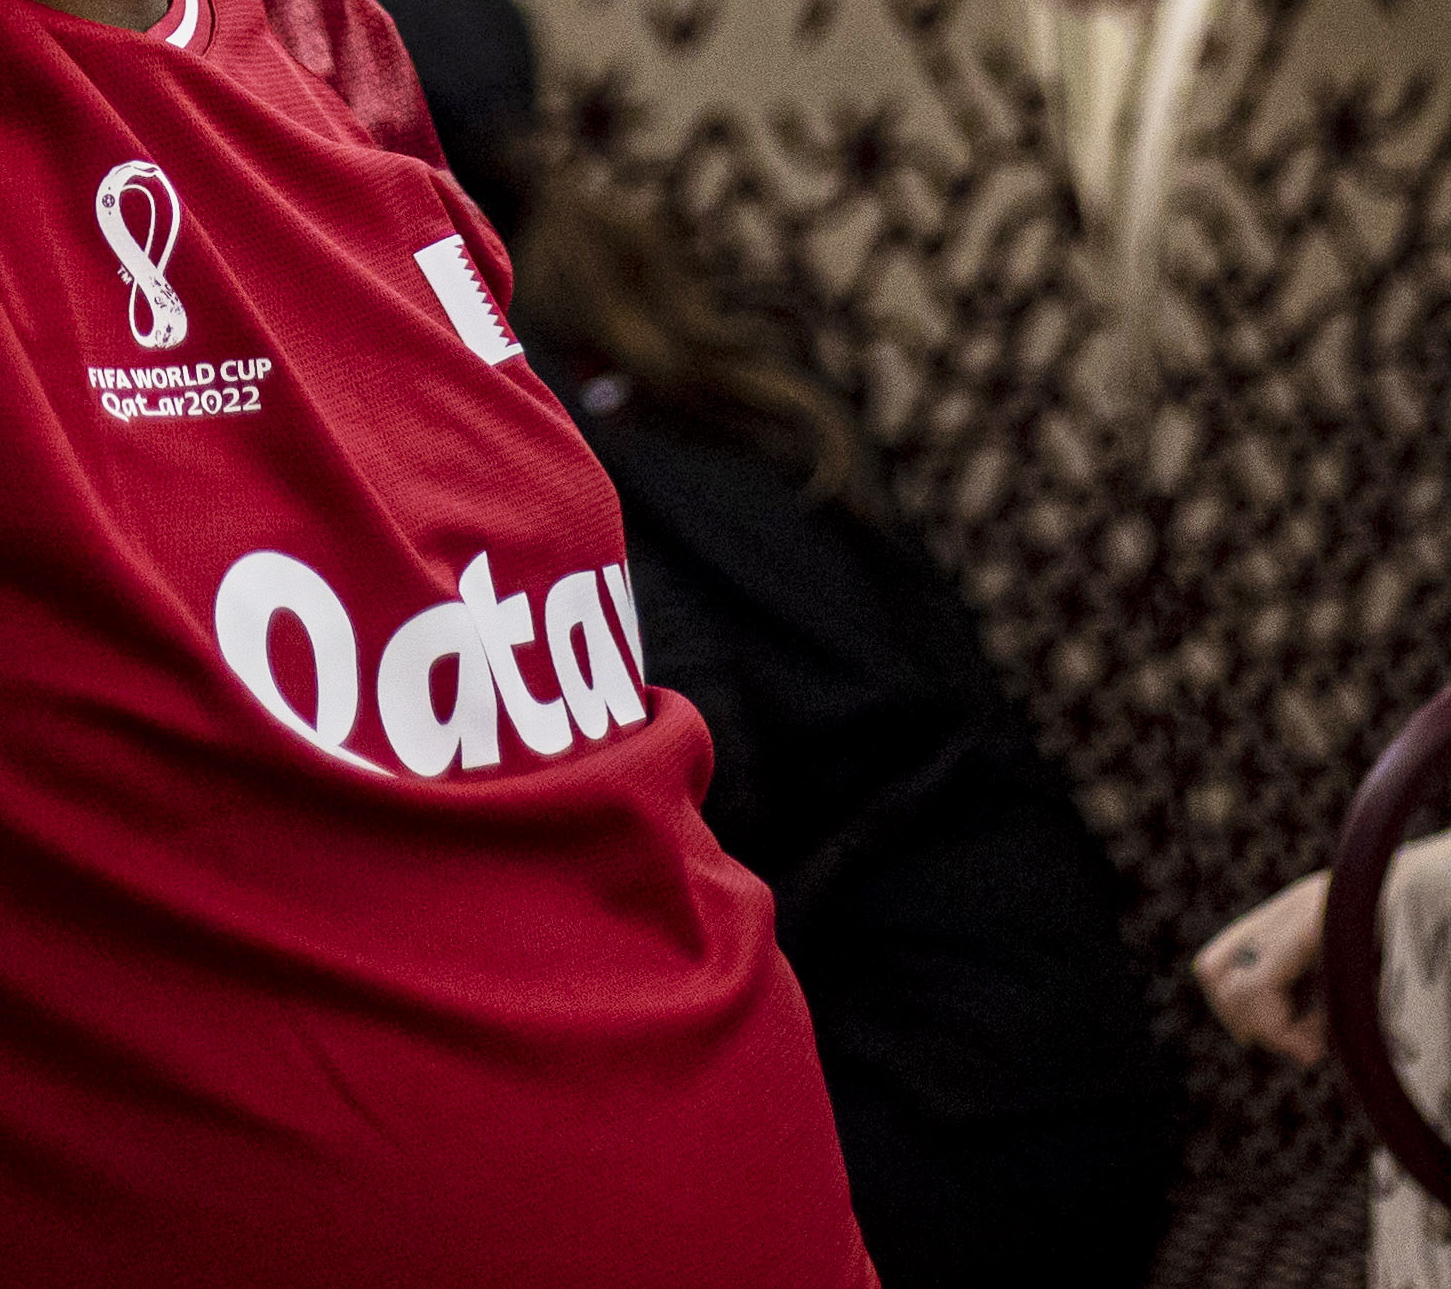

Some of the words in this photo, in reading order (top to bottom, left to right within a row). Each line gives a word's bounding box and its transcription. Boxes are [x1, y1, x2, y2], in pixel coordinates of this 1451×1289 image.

[87, 366, 132, 390] FIFA
[131, 362, 215, 390] WORLD
[219, 357, 272, 383] CUP
